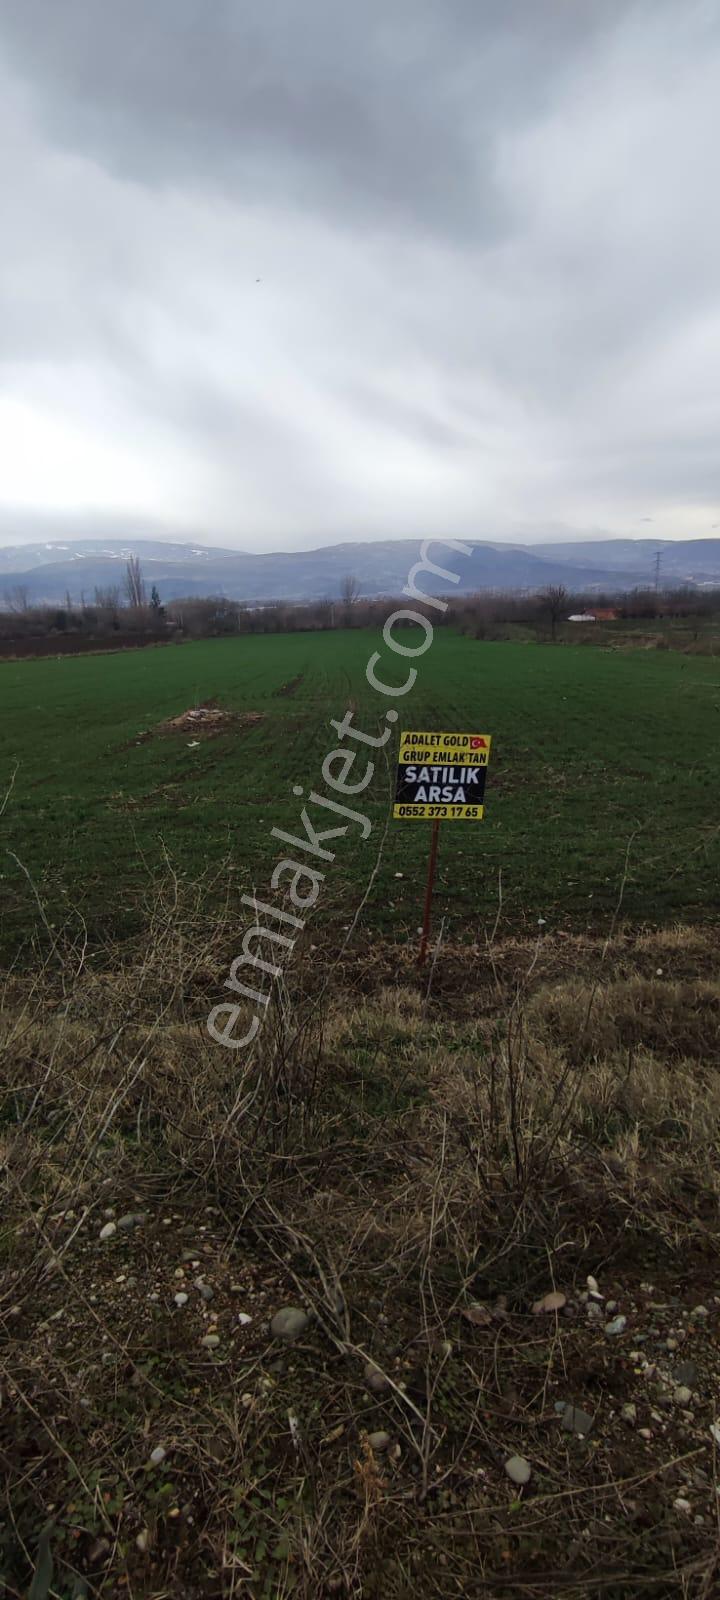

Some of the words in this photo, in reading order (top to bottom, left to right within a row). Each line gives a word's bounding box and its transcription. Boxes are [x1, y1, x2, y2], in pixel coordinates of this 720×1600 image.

[404, 734, 442, 746] ADALET
[443, 735, 469, 747] GOLD
[403, 750, 431, 762] GRUP
[432, 751, 487, 764] EMLAK'TAN
[404, 766, 480, 784] SATILIK
[414, 785, 467, 803] ARSA
[398, 806, 425, 816] 0552
[428, 806, 448, 817] 373
[451, 807, 463, 817] 17
[465, 807, 478, 817] 65
